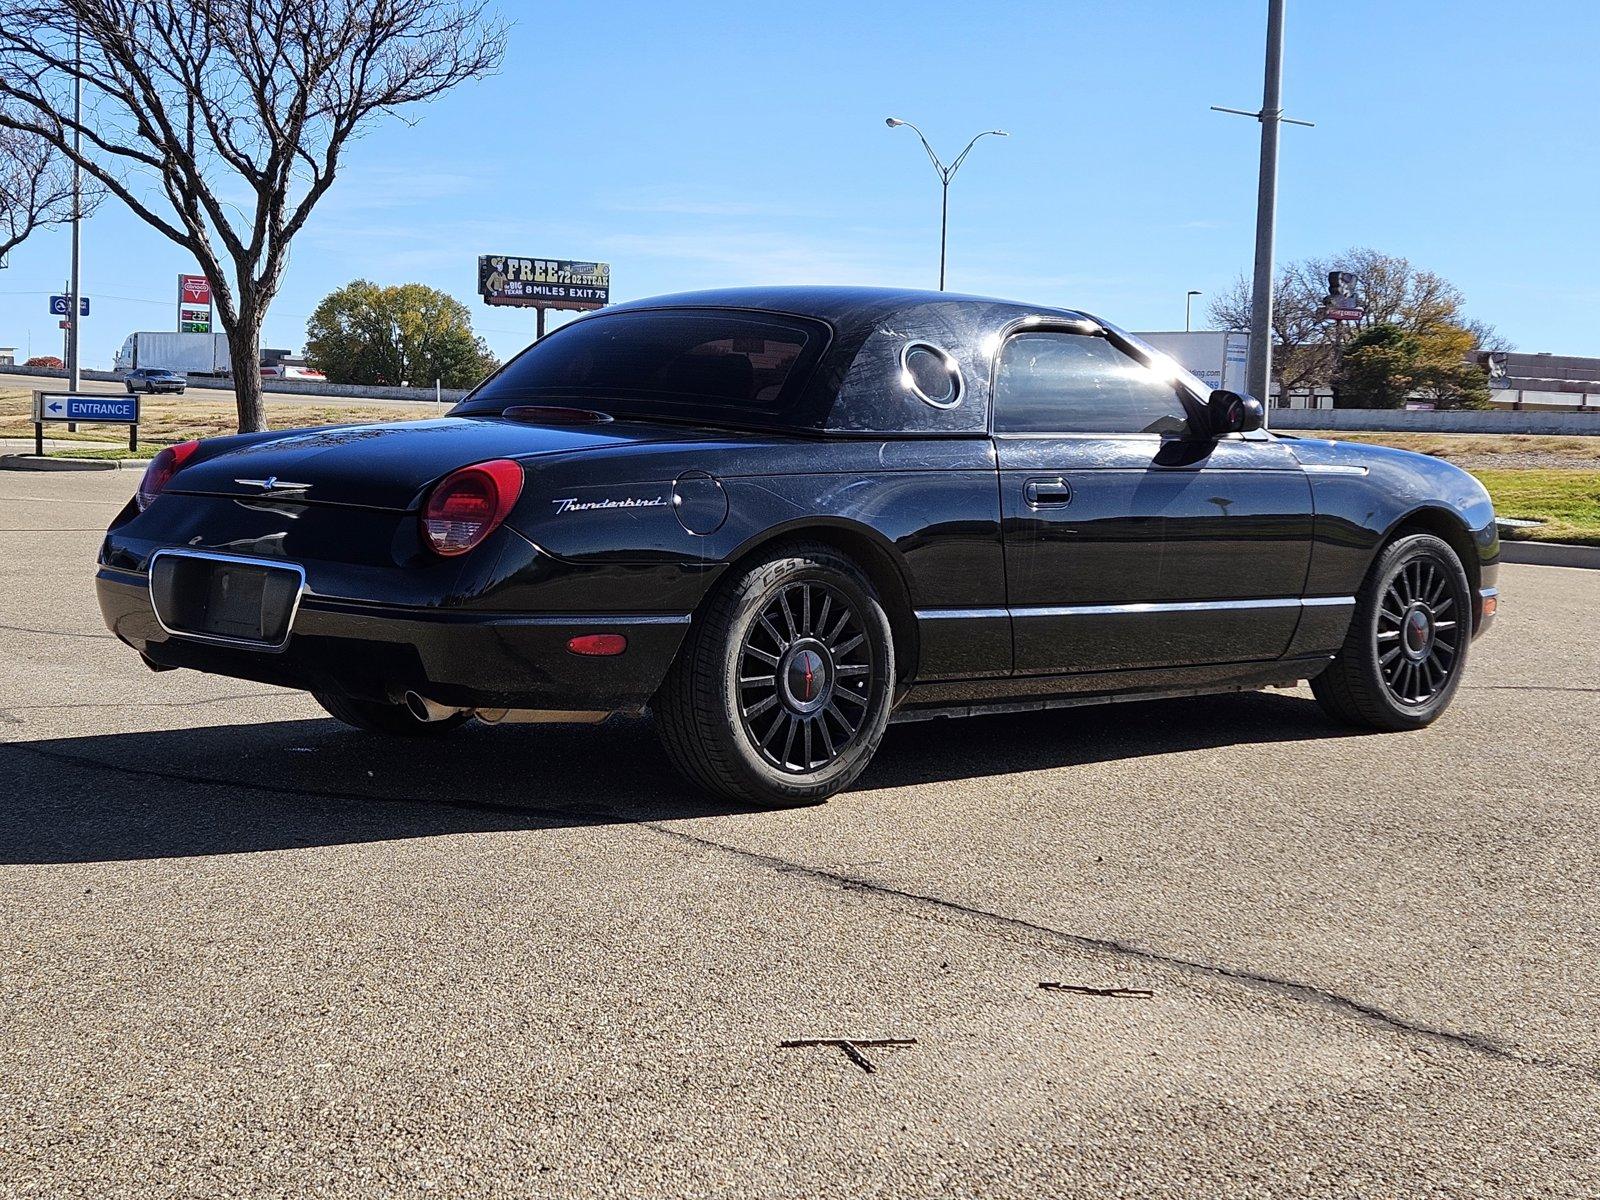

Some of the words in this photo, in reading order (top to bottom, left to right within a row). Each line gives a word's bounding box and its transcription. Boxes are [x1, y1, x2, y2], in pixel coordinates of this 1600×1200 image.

[507, 258, 558, 283] FREE
[510, 281, 522, 289] BIG
[558, 271, 571, 284] 72
[571, 275, 582, 285] OZ
[582, 275, 608, 286] STEAK
[505, 288, 523, 296] TEXAN
[525, 285, 532, 294] 8
[533, 286, 565, 296] MILES
[569, 288, 593, 298] EXIT
[594, 290, 606, 299] 75
[71, 403, 130, 415] ENTRANCE
[552, 496, 667, 515] Thunderbird
